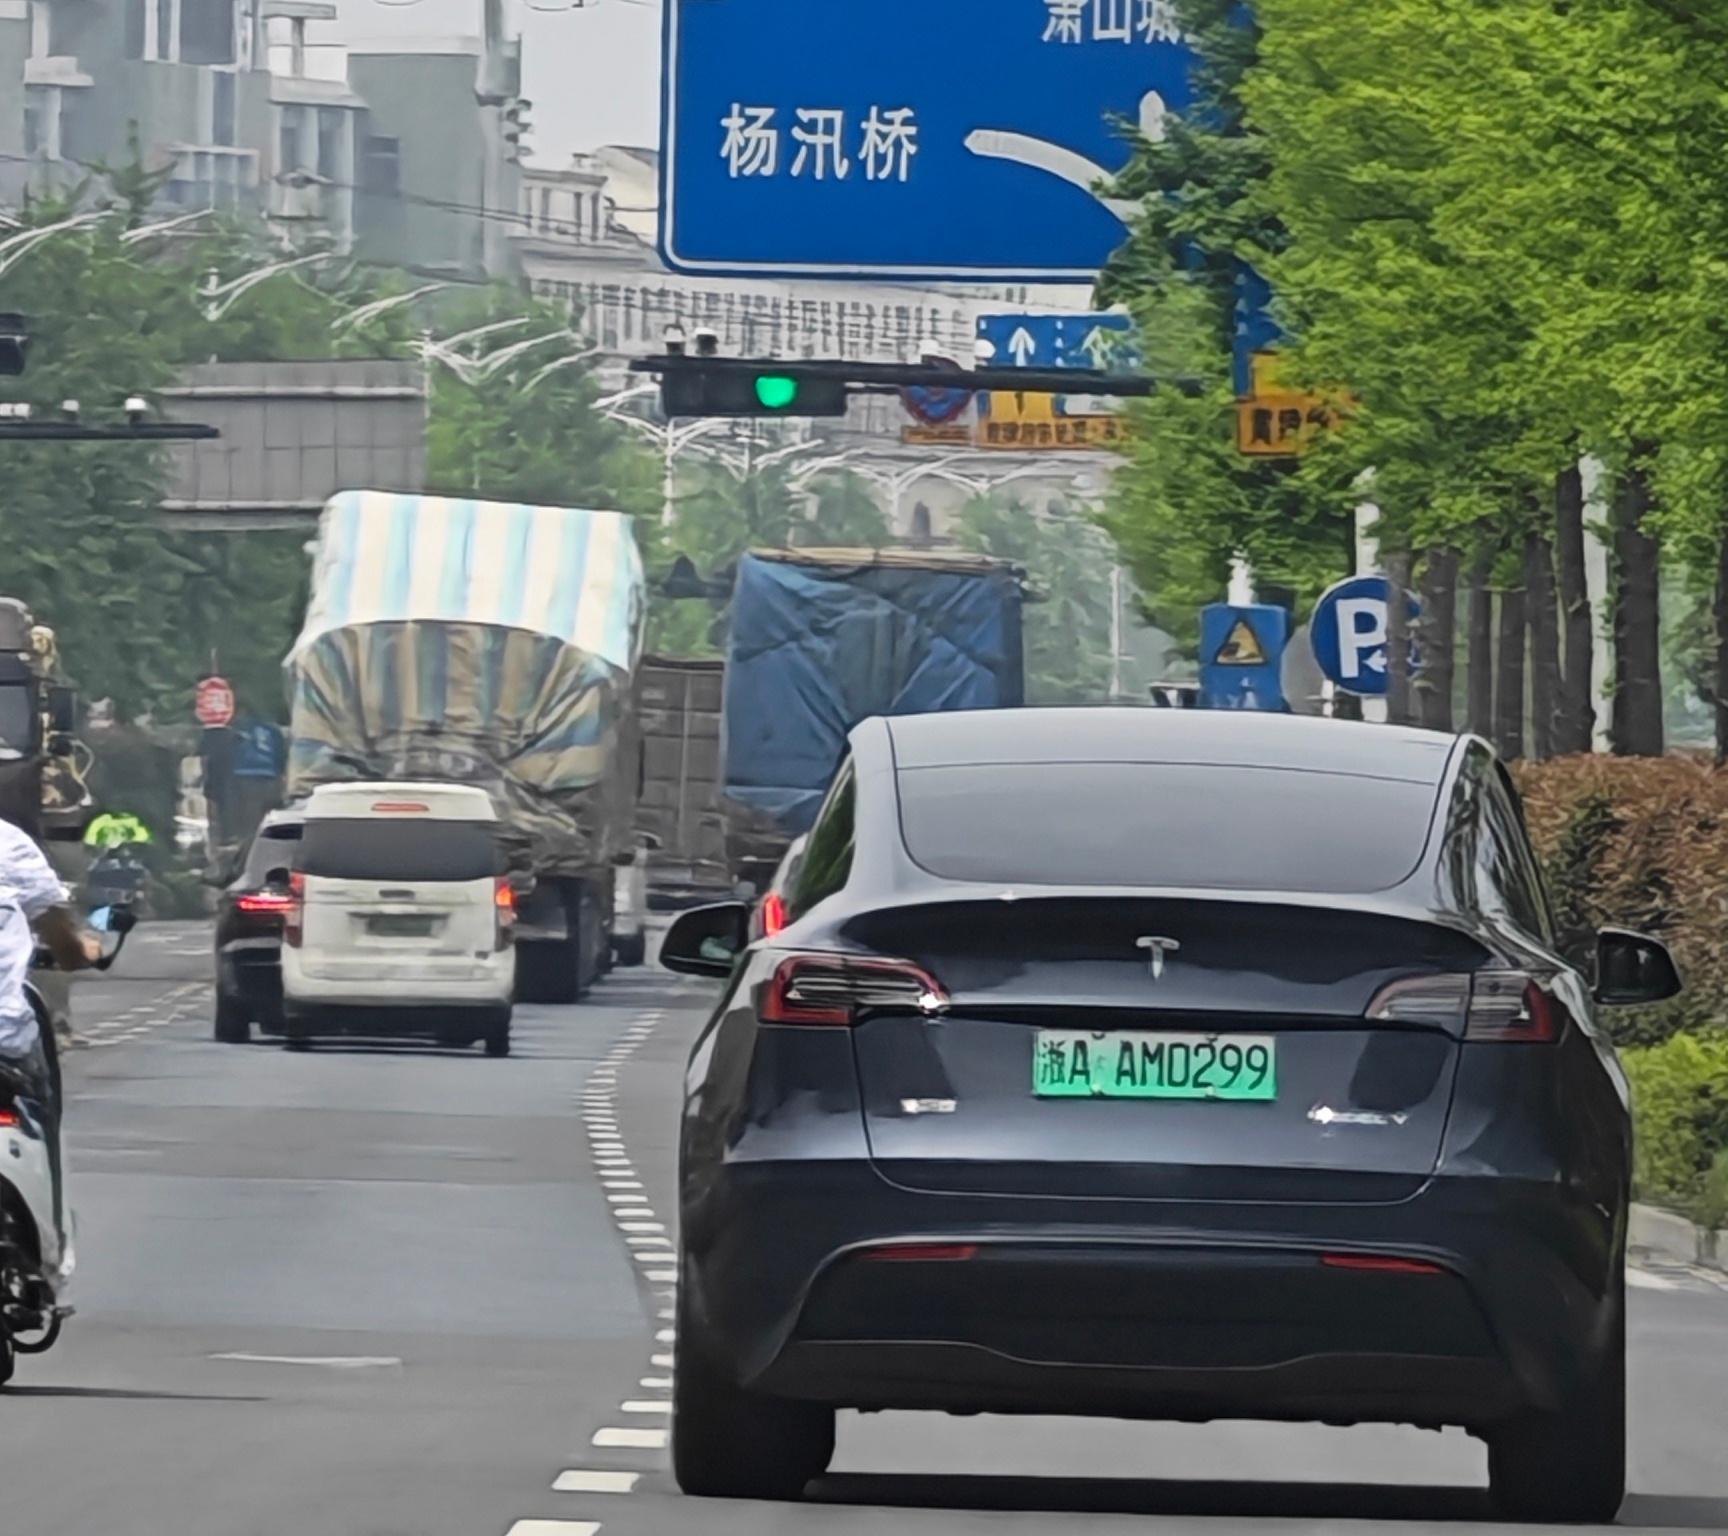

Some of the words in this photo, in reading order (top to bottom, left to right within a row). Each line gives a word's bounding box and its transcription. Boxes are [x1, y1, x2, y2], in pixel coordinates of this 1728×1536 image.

[719, 102, 918, 182] 杨汛桥
[1335, 597, 1388, 679] P
